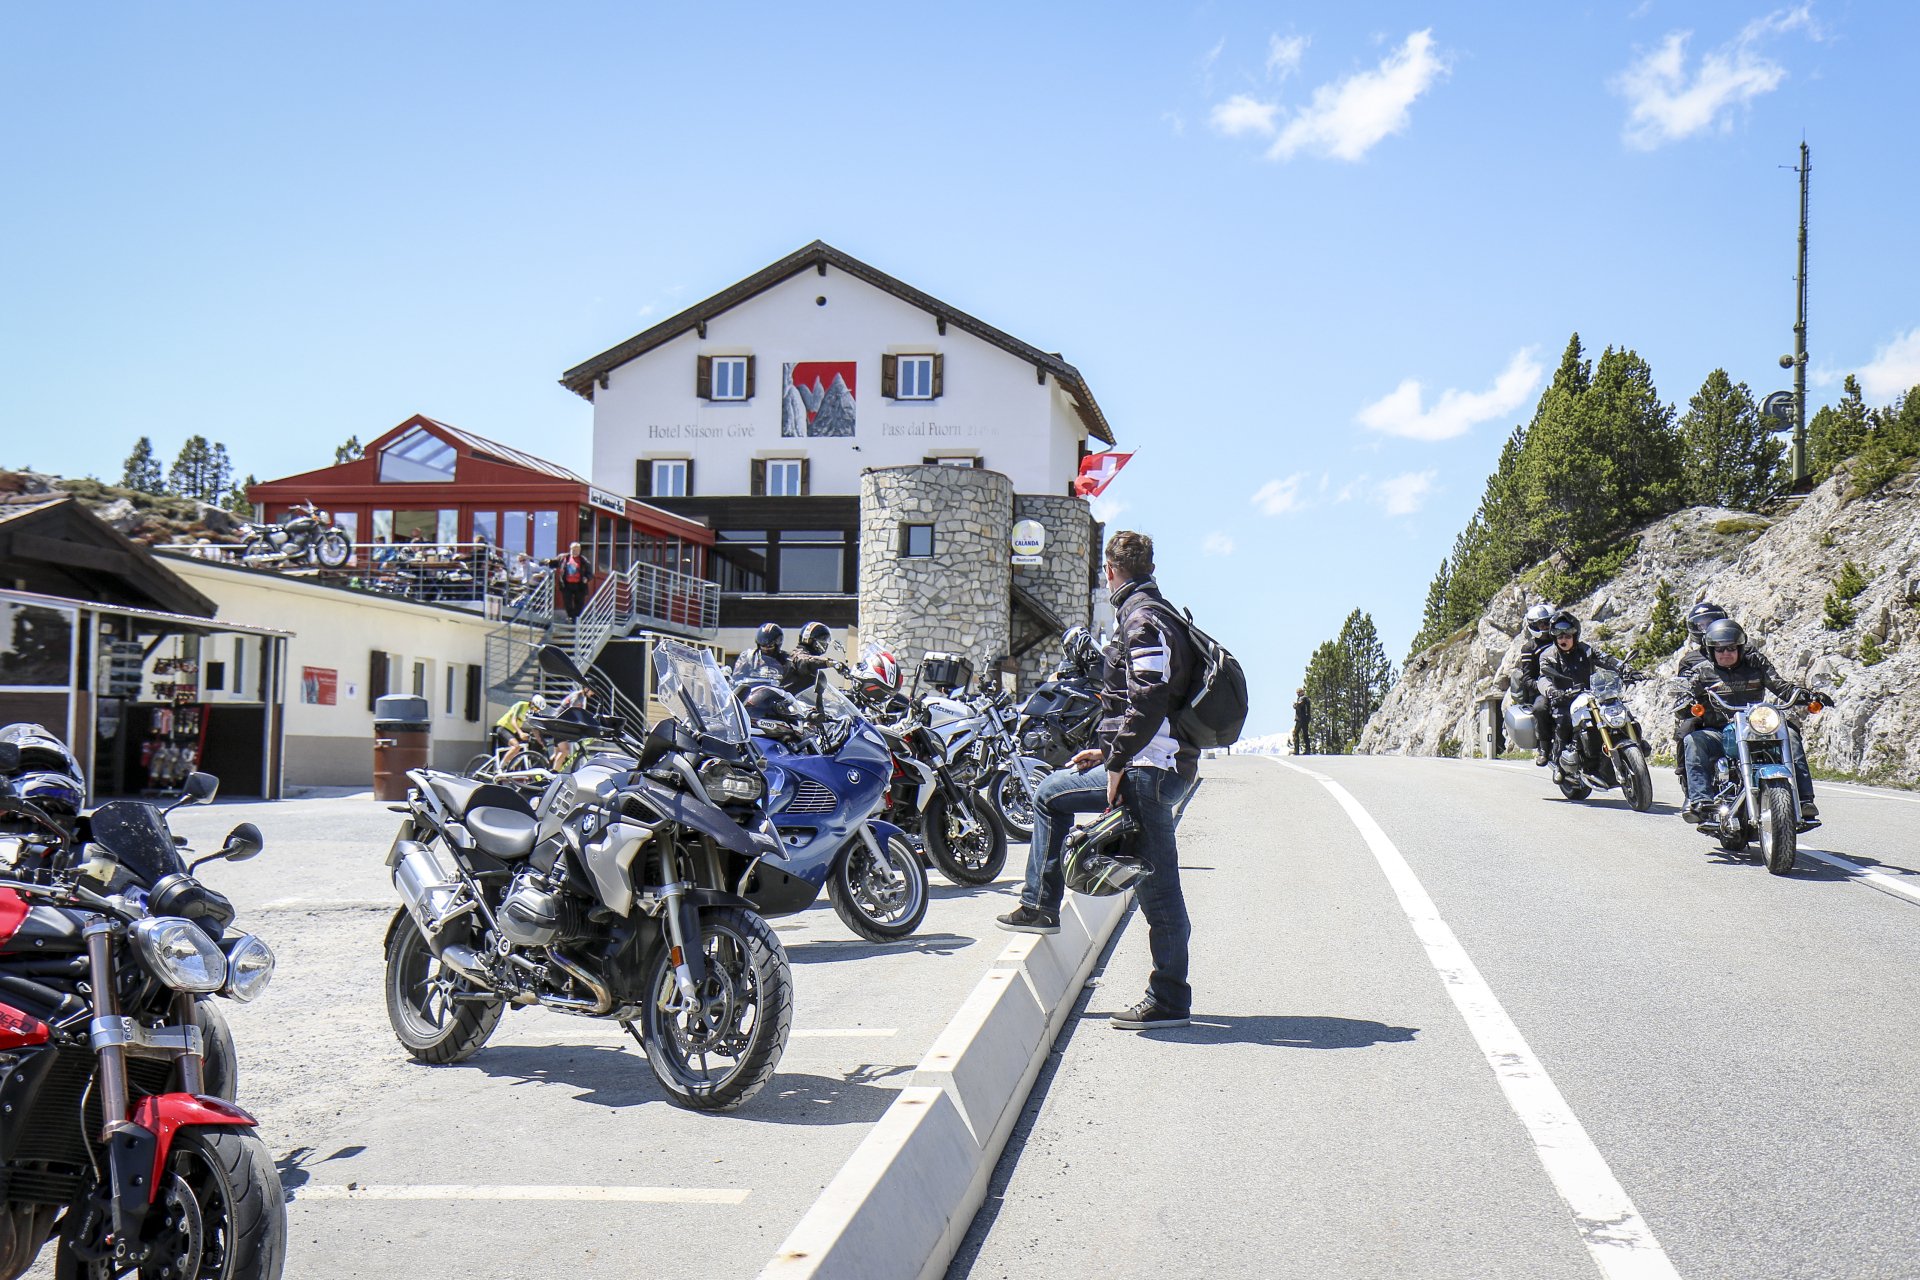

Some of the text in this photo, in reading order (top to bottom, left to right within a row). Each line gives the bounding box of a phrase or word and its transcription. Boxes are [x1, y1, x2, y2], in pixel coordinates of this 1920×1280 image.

[649, 425, 680, 438] Hotel
[882, 423, 905, 436] Pass
[908, 421, 925, 436] dal
[929, 422, 961, 436] Fuorn
